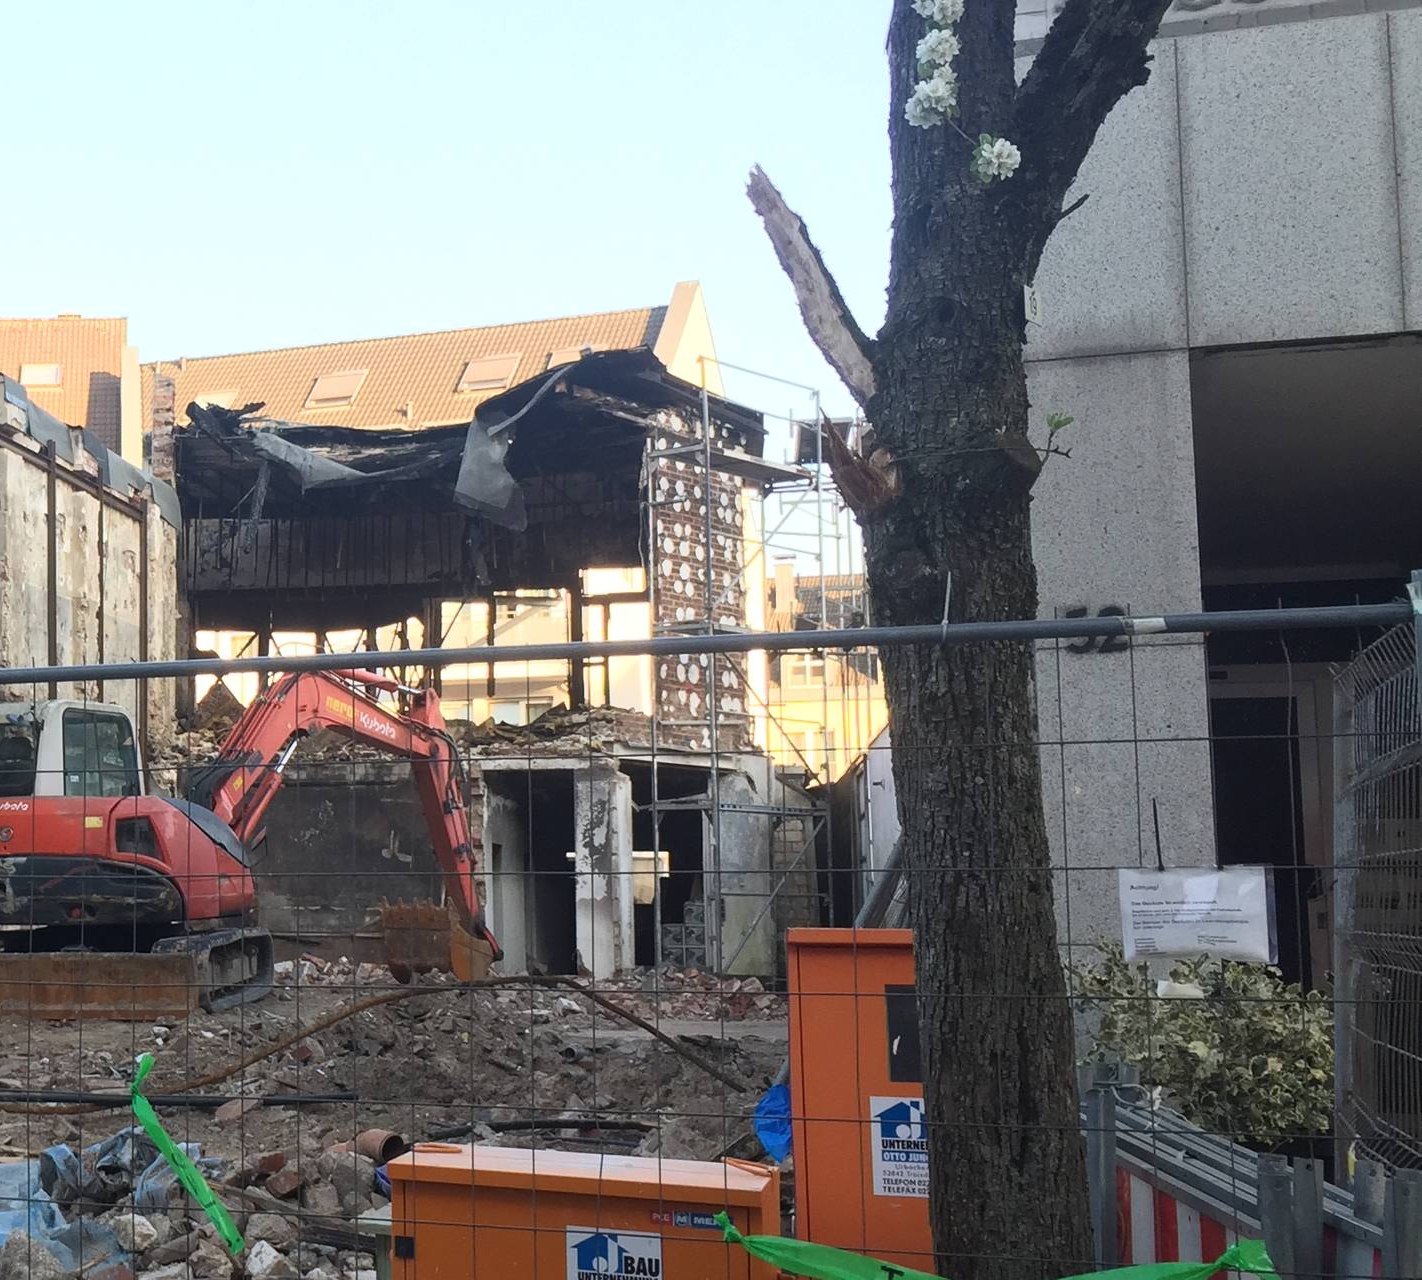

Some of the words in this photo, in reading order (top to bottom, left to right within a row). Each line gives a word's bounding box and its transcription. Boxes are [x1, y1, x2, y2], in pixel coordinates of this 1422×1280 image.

[359, 711, 396, 739] Kubota
[882, 1139, 929, 1150] UNTERNE
[883, 1151, 907, 1161] OTTO
[882, 1178, 916, 1186] TELEFON
[882, 1186, 916, 1194] TELEFAX
[624, 1256, 660, 1278] BAU
